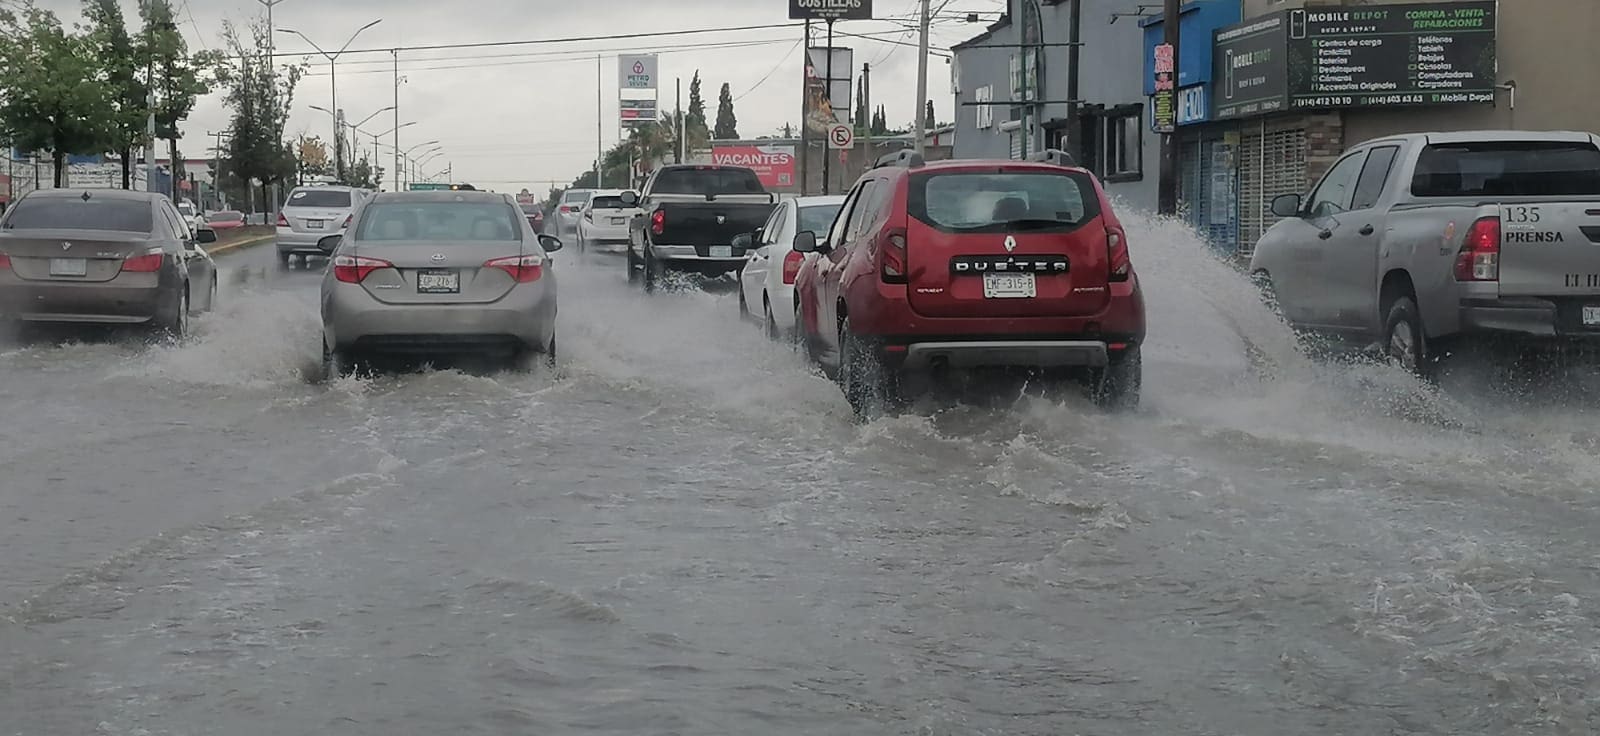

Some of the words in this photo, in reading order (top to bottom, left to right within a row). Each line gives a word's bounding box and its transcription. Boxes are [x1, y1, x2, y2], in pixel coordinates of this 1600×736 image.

[1308, 12, 1349, 22] MOBILE
[1353, 11, 1388, 20] DEPOT
[1405, 11, 1446, 19] COMPRA
[1454, 9, 1485, 18] VENTA
[1413, 19, 1483, 29] REPARACIONES
[1360, 82, 1396, 90] Originales
[1440, 93, 1467, 102] Mobile
[714, 154, 789, 165] VACANTES
[1505, 207, 1540, 223] 135
[1506, 232, 1564, 243] PRENSA
[956, 262, 1066, 271] DUSTER
